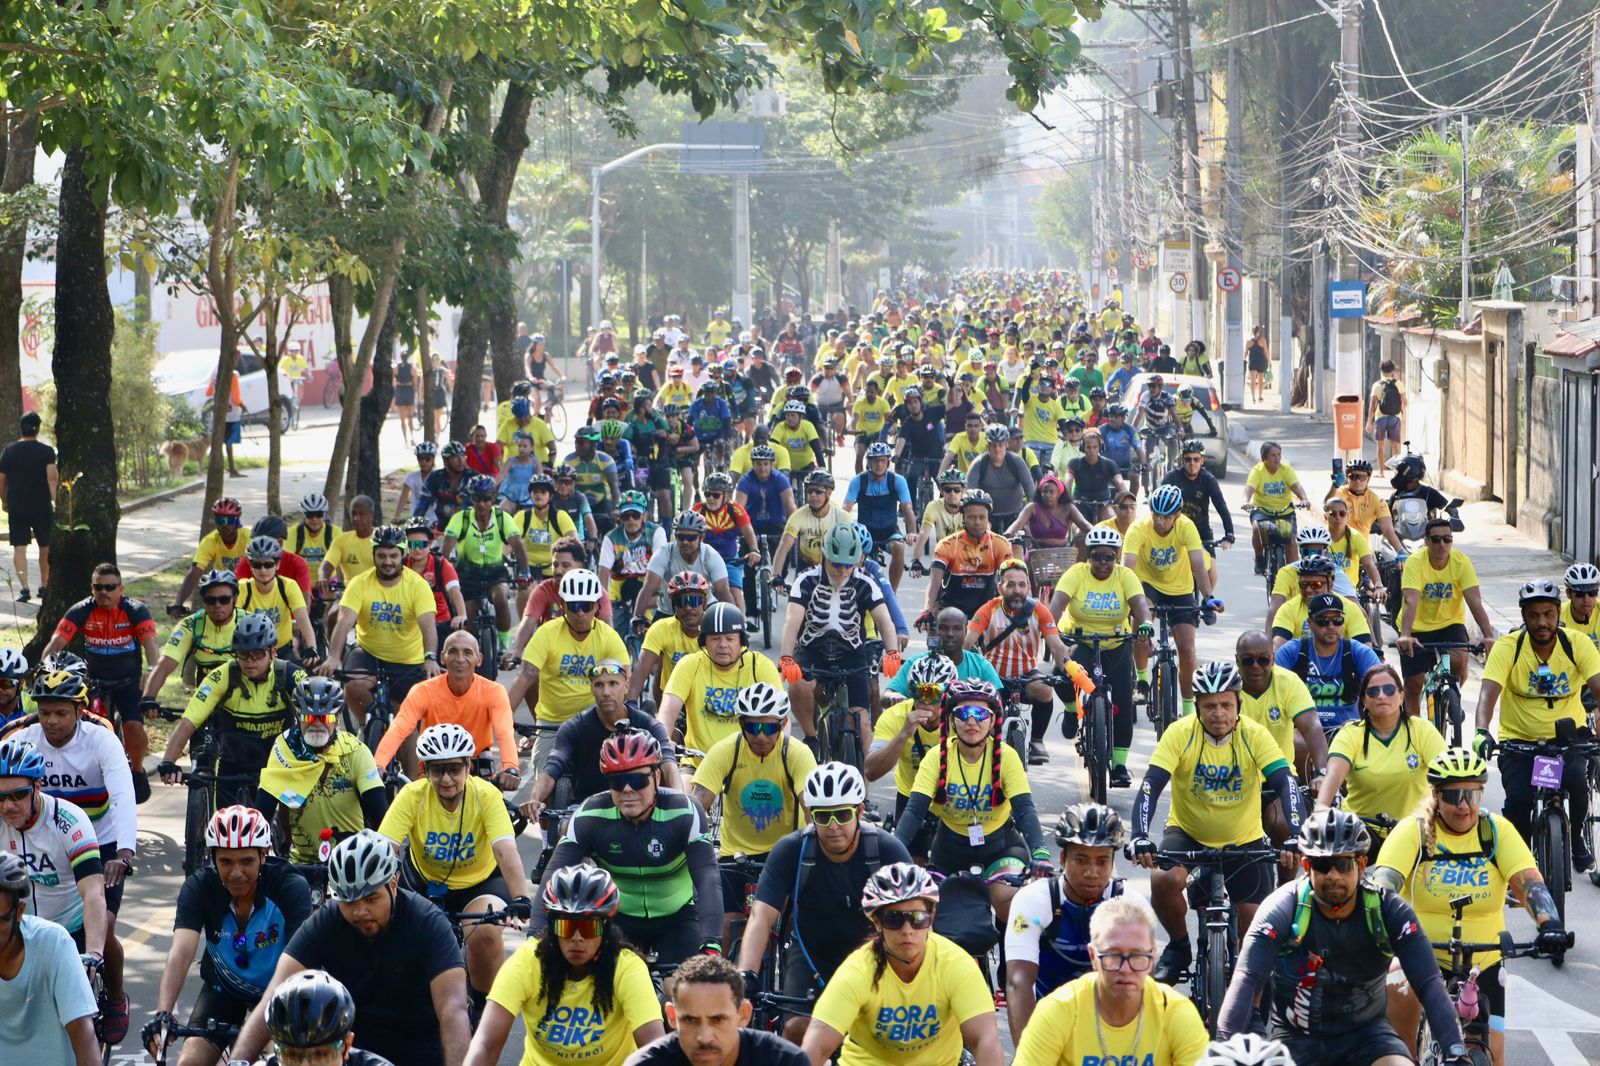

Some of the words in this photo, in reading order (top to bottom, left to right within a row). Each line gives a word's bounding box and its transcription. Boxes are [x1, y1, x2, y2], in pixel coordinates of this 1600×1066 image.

[1174, 278, 1184, 286] 30
[1151, 545, 1176, 556] BORA
[1155, 554, 1178, 566] BIKE
[1087, 591, 1117, 601] BORA
[371, 601, 402, 614] BORA
[1091, 600, 1121, 611] BIKE
[378, 612, 403, 625] BIKE
[561, 654, 596, 666] BORA
[705, 686, 743, 701] BOR
[713, 700, 738, 713] BIK
[1194, 763, 1242, 781] BORA
[947, 782, 992, 798] BORA
[1203, 778, 1244, 793] BIKE
[425, 831, 475, 848] BORA
[434, 846, 476, 863] BIKE
[1441, 869, 1489, 887] BIKE
[877, 1004, 937, 1025] BORA
[548, 1024, 605, 1048] BIKE
[875, 1022, 889, 1032] DE
[889, 1020, 941, 1042] BIKE
